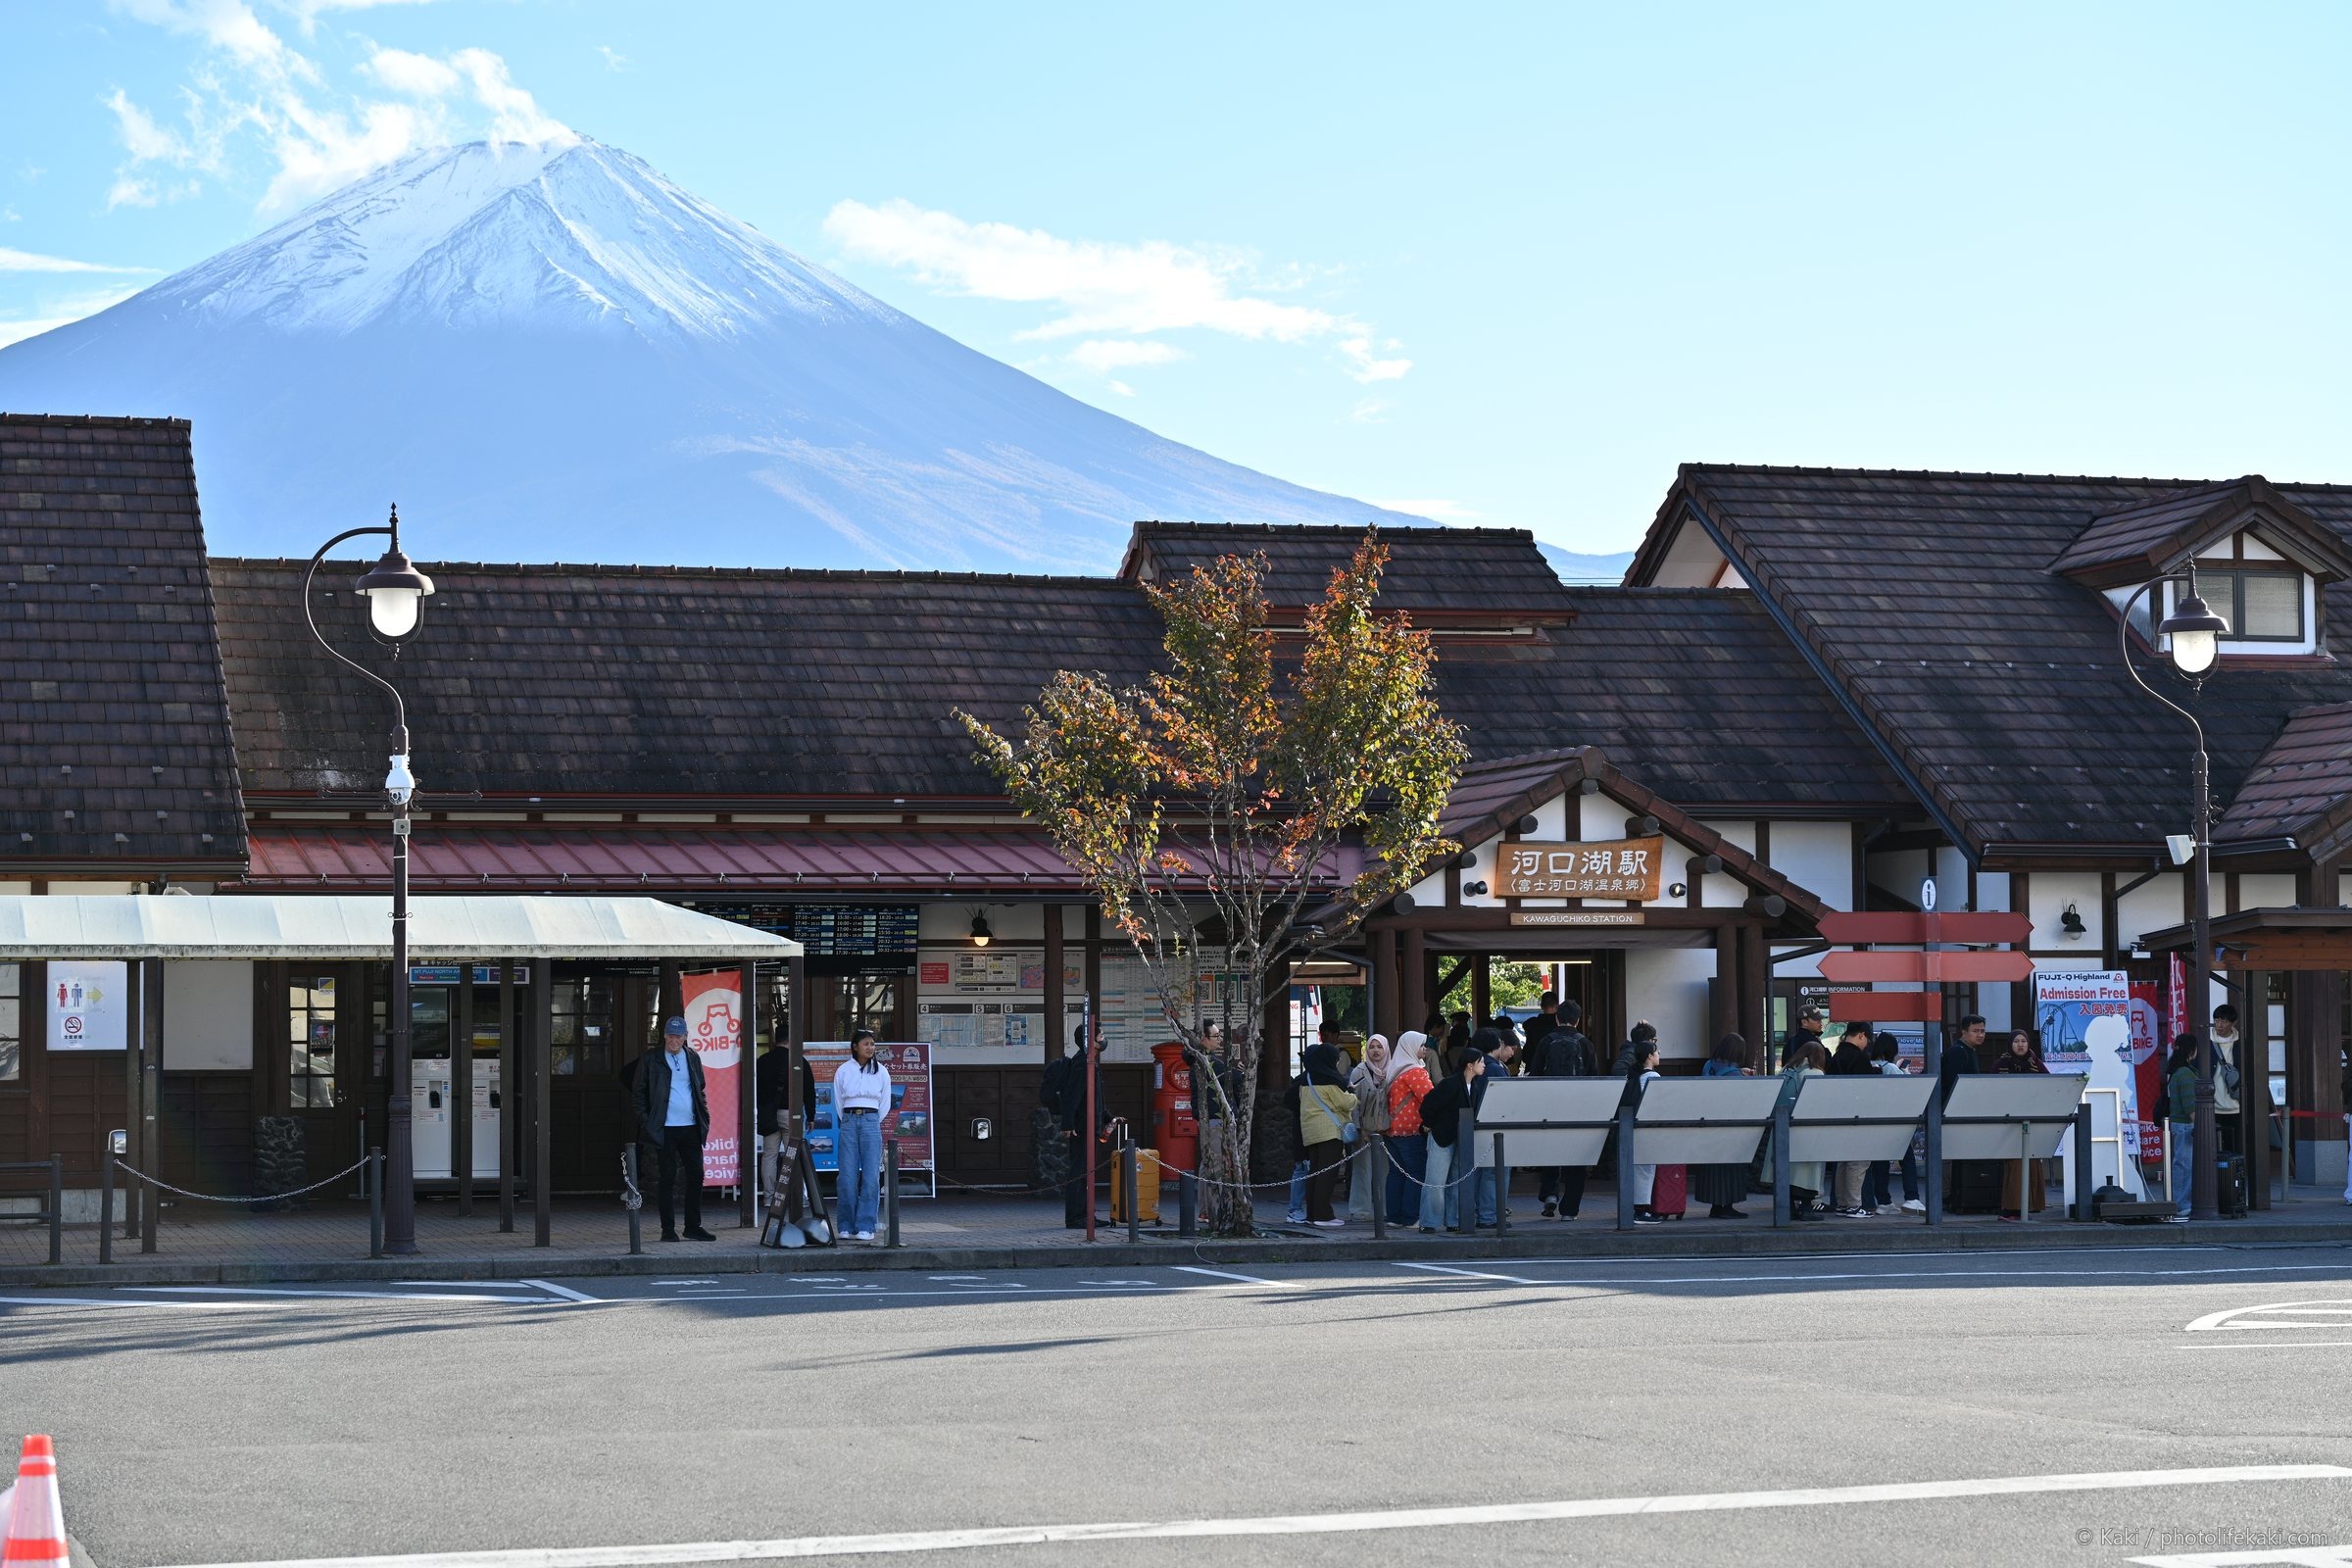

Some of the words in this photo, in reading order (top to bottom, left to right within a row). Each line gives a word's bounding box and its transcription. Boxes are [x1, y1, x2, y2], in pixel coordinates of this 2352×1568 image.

[1511, 850, 1650, 876] 河口湖駅
[2039, 987, 2097, 1000] Admission
[2099, 987, 2127, 999] Free
[2079, 1003, 2128, 1015] 入园免费
